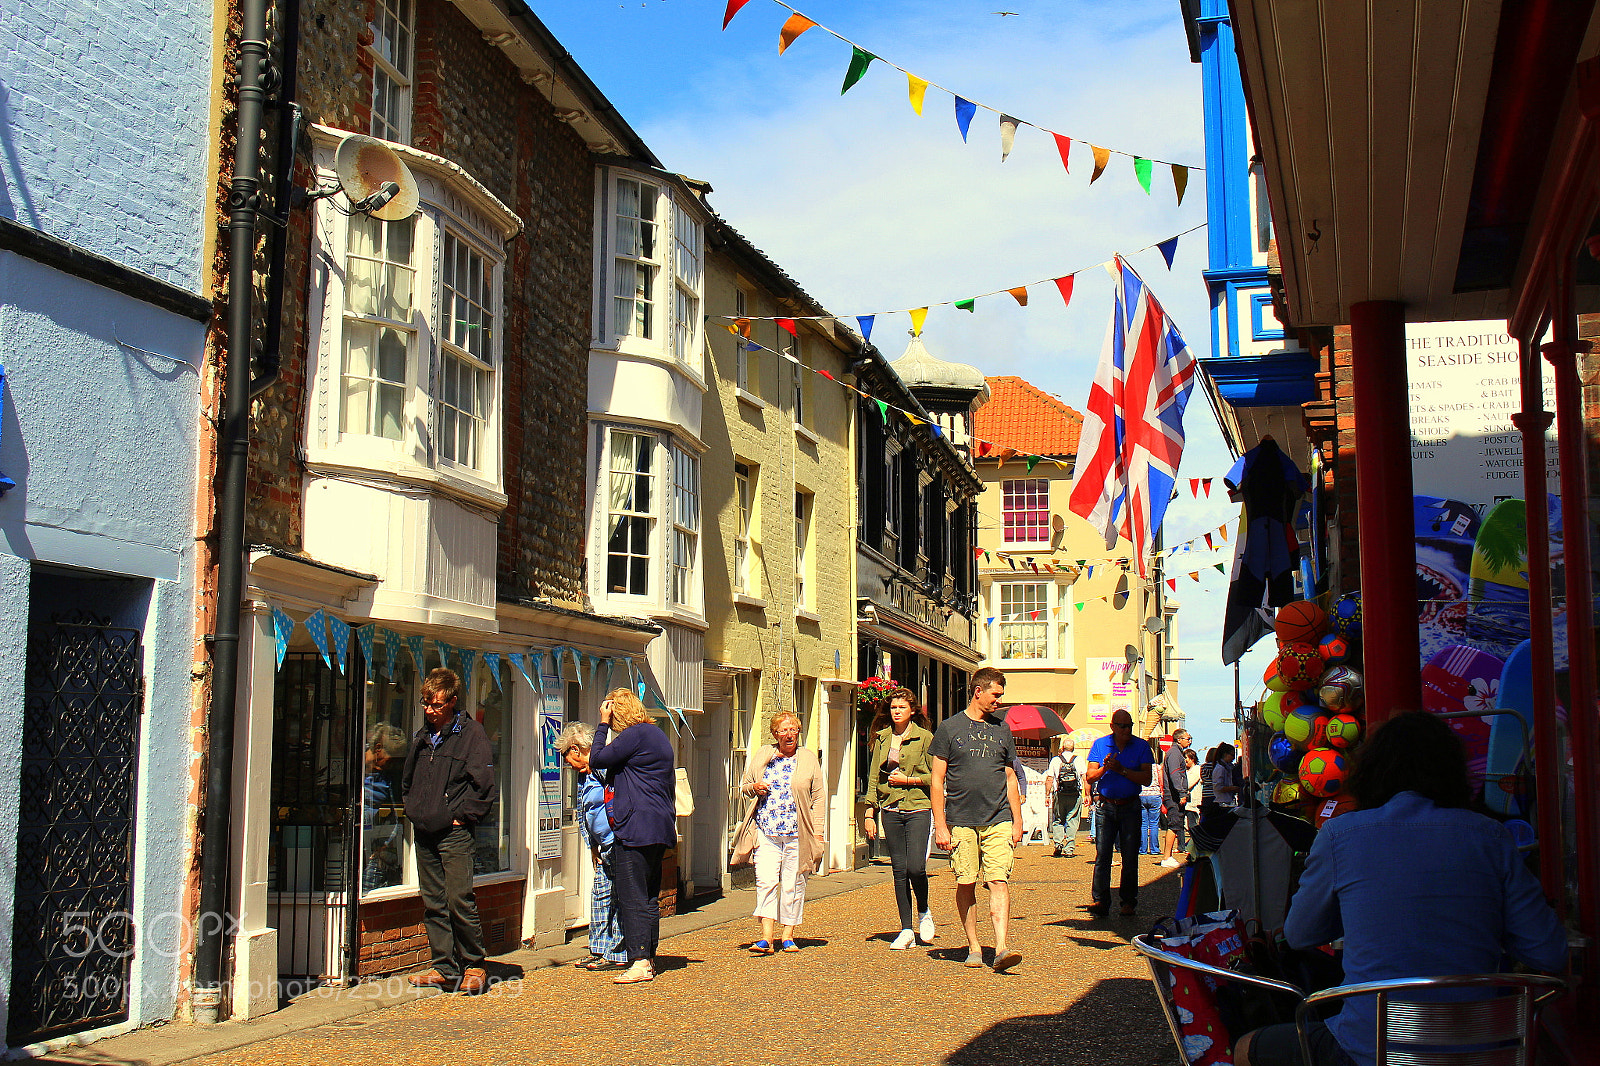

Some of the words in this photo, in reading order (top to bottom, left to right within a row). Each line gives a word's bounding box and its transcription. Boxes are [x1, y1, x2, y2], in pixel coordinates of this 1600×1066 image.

[1435, 333, 1514, 347] TRADITIO
[1418, 352, 1482, 367] SEASIDE
[1487, 351, 1519, 364] SHO
[1415, 380, 1442, 390] MATS
[1481, 377, 1508, 386] CRAB
[1492, 389, 1513, 398] BAIT
[1438, 402, 1474, 412] SPADES
[1482, 401, 1509, 410] CRAB
[1483, 412, 1512, 421] NAUT
[1418, 426, 1450, 436] SHOES
[1483, 423, 1519, 433] SUNGL
[1410, 438, 1448, 448] TABLES
[1484, 435, 1509, 444] POST
[1412, 450, 1435, 459] UITS
[1485, 447, 1522, 456] JEWELL
[1485, 458, 1524, 468] WATCHE
[1486, 470, 1520, 480] FUDGE
[1102, 660, 1132, 673] Whippy
